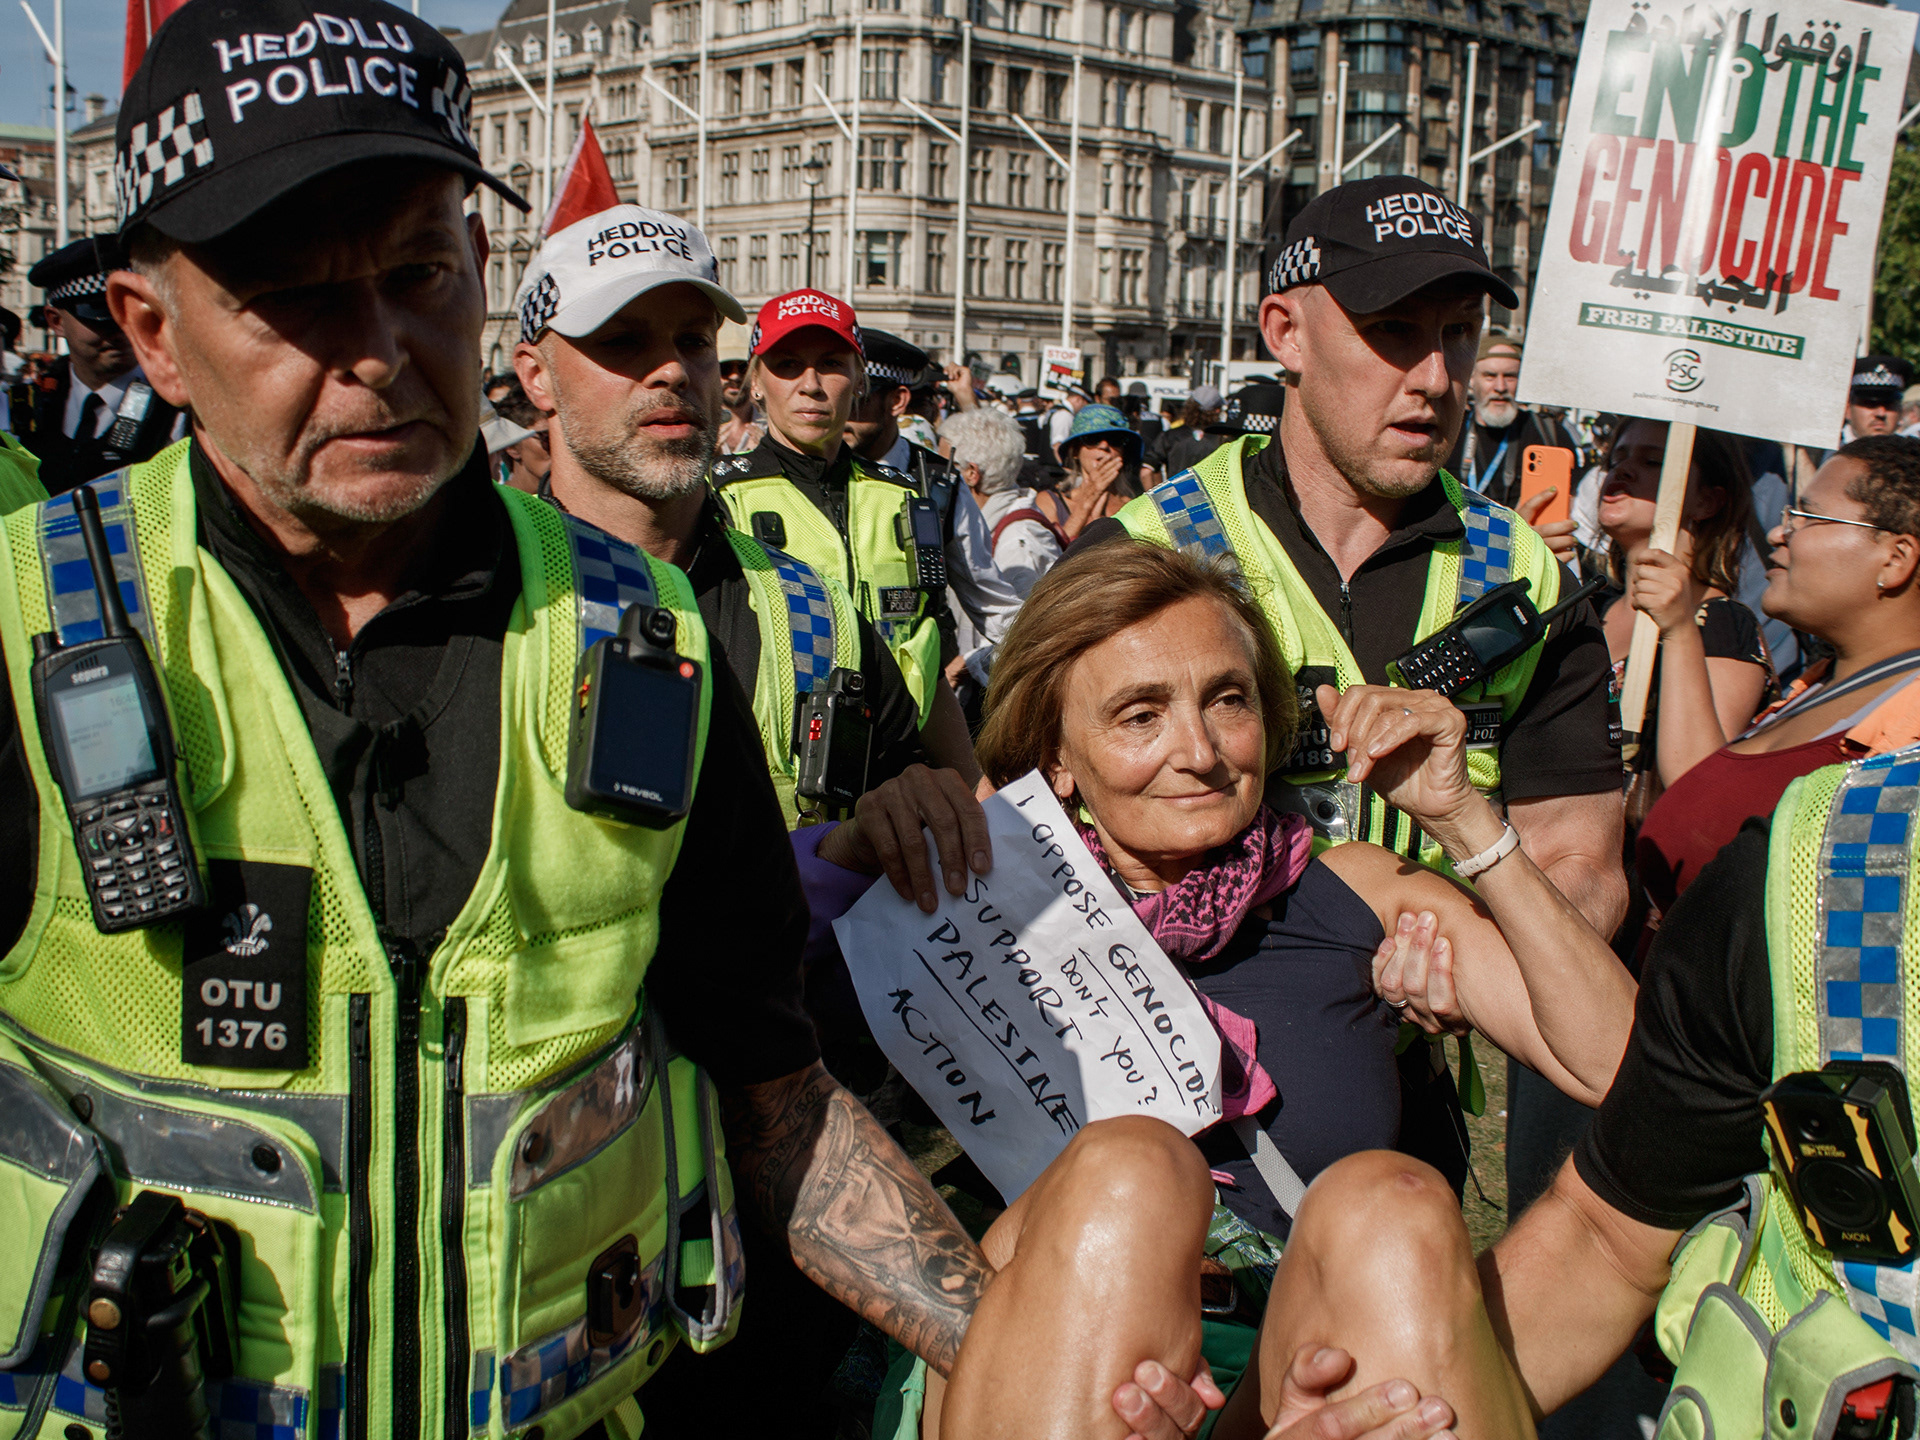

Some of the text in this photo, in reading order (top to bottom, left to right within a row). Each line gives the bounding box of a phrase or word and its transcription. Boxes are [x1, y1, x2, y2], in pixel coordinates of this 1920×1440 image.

[212, 12, 414, 73] HEDDLU
[225, 56, 419, 124] POLICE
[1591, 30, 1882, 173] END THE
[1365, 192, 1470, 223] HEDDLU
[1569, 133, 1862, 302] GENOCIDE
[587, 221, 688, 252] HEDDLU
[1373, 214, 1475, 248] POLICE
[588, 238, 694, 267] POLICE
[777, 304, 841, 322] POLICE
[778, 294, 838, 312] HEDDLU
[1585, 306, 1799, 356] FREE PALESTINE
[1668, 362, 1699, 380] PSC
[1154, 386, 1193, 396] POLIC
[1015, 794, 1035, 809] I
[1032, 823, 1113, 931] OPPOSE
[964, 877, 1084, 1042] SUPPORT
[200, 977, 282, 1011] OTU
[196, 1017, 288, 1052] 1376
[926, 916, 1081, 1138] PALESTINE
[887, 987, 998, 1126] ACTION
[1841, 1231, 1871, 1242] AXON
